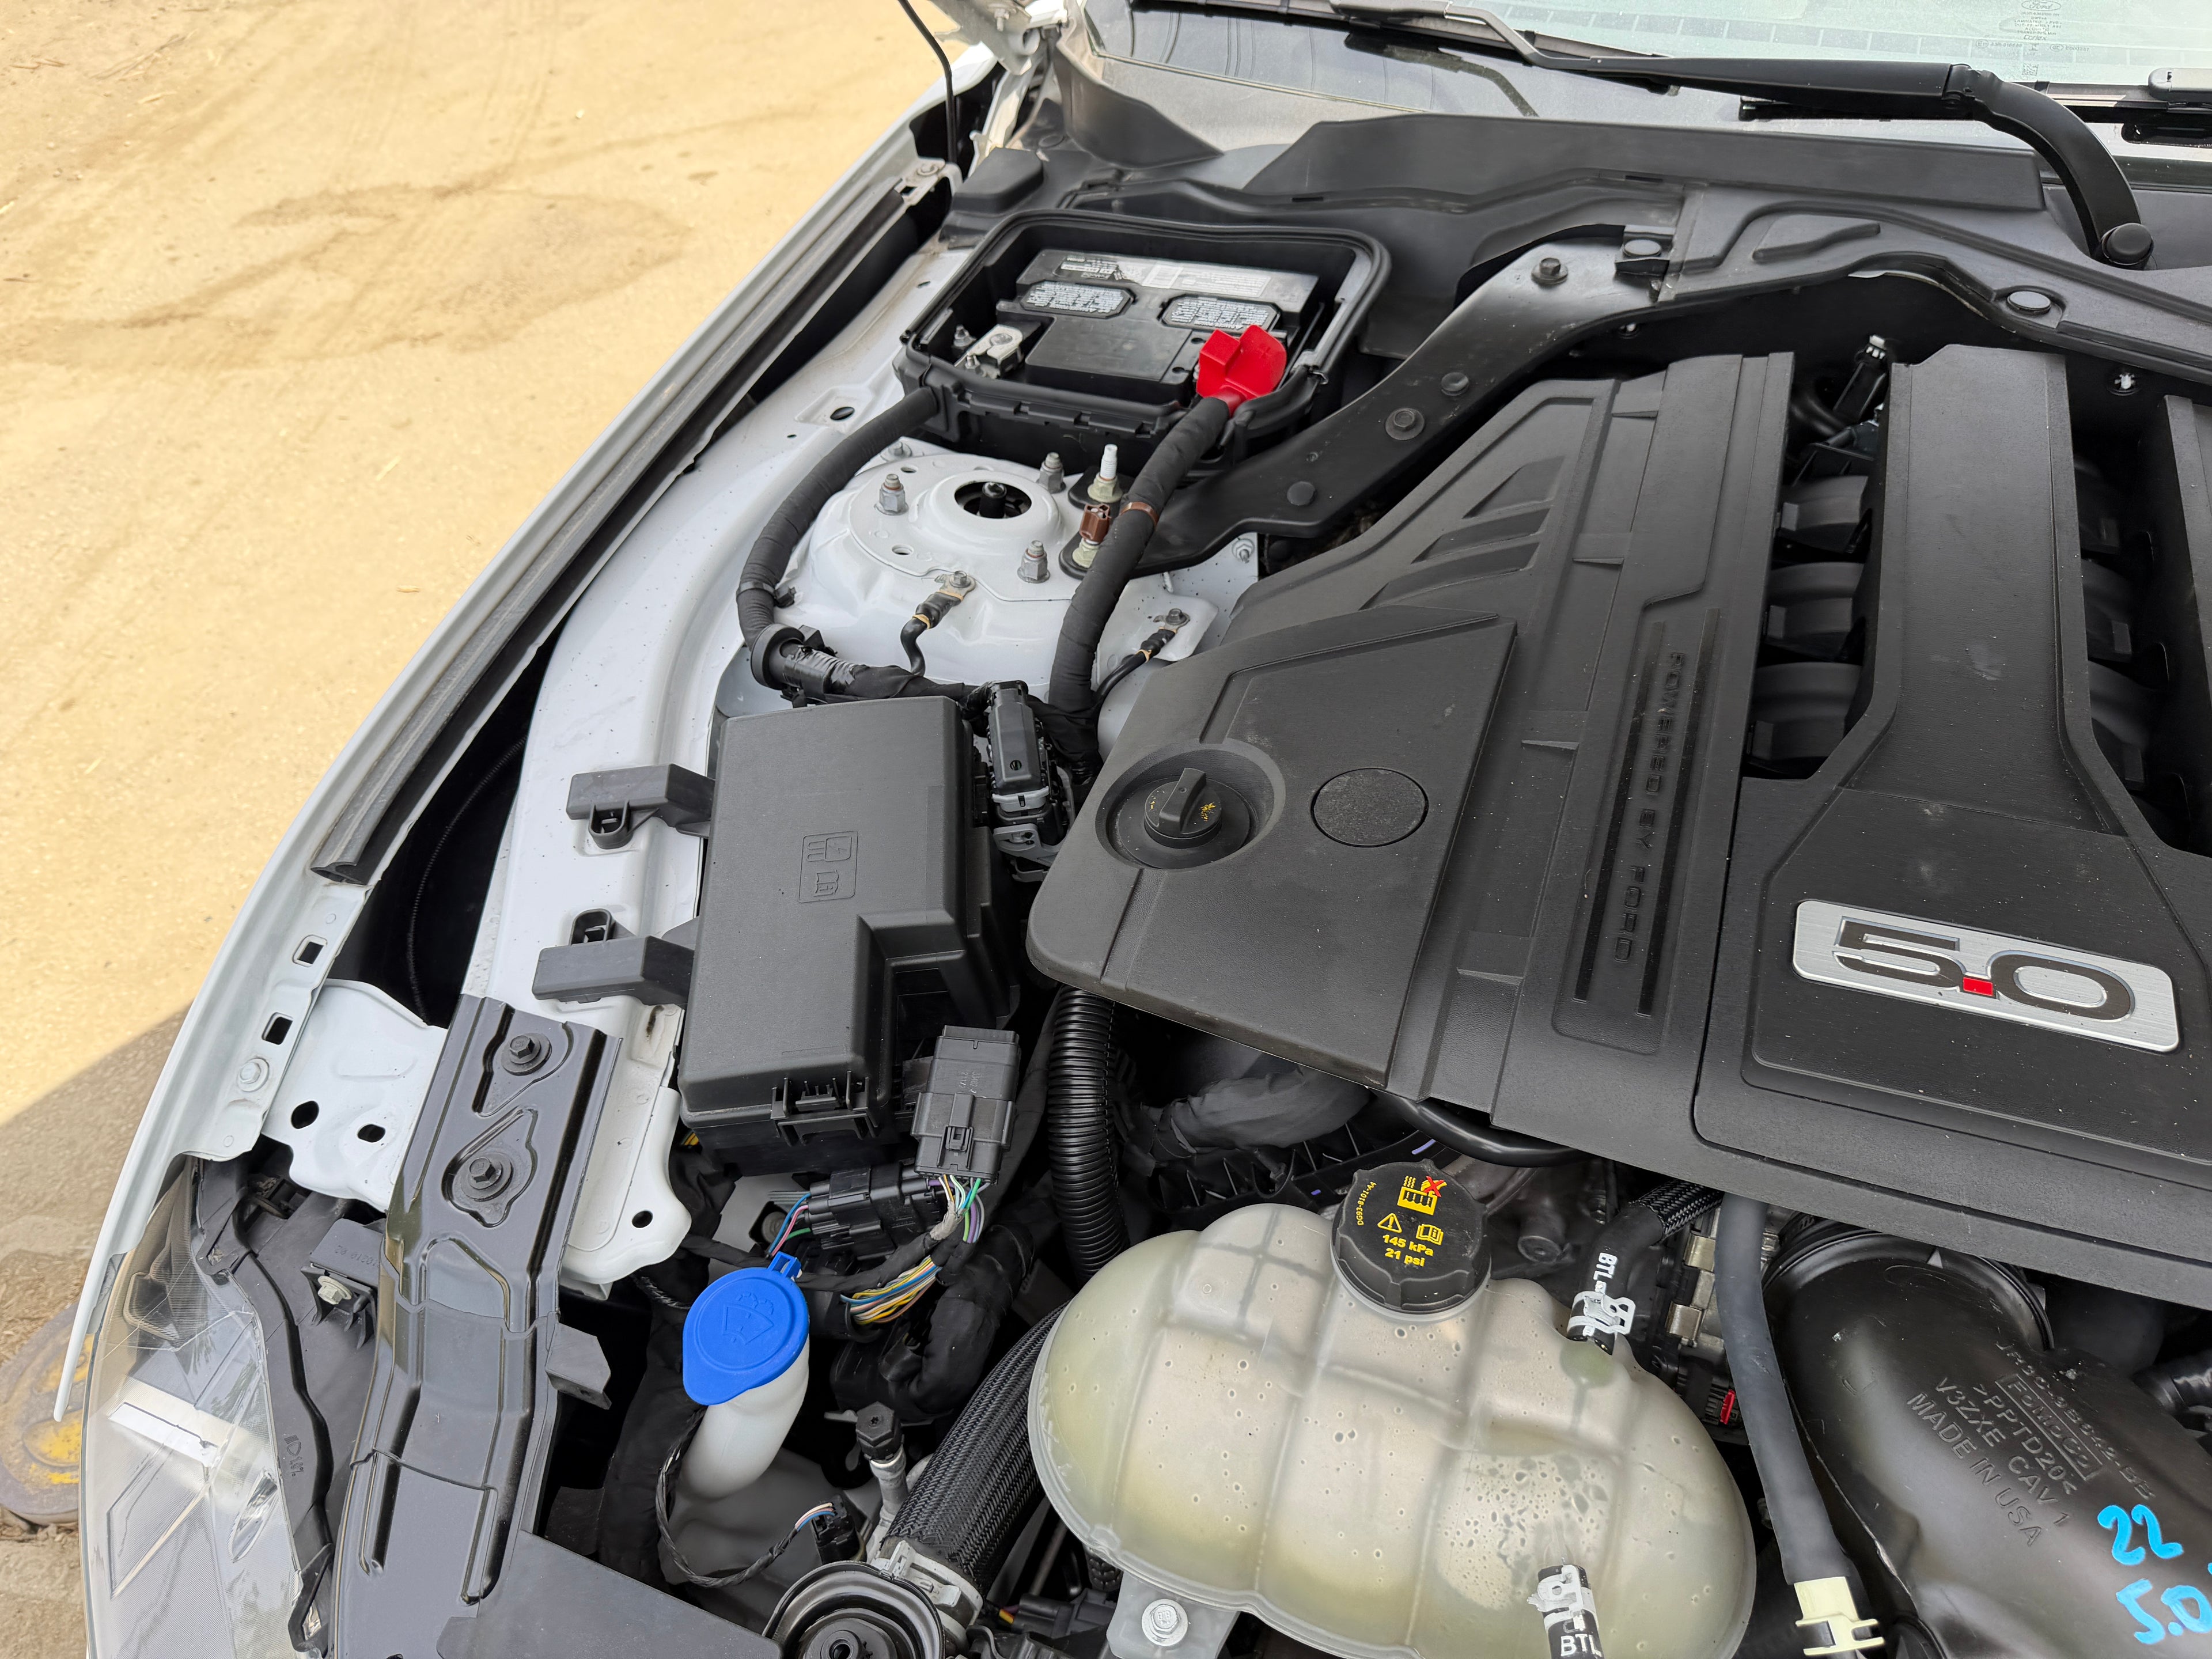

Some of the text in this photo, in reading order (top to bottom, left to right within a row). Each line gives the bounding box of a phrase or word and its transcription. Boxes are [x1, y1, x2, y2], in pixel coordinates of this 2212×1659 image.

[2029, 2, 2053, 10] Ford
[1613, 651, 1685, 963] POWERED BY FORD
[1832, 915, 2136, 1023] 5.0
[1357, 1181, 1377, 1226] DG93-8101-AA
[1382, 1234, 1434, 1257] 145 kPa
[1384, 1248, 1425, 1267] 21 psi
[1593, 1252, 1619, 1281] BTL
[1907, 1392, 2043, 1548] MADE IN USA
[2008, 1456, 2059, 1506] CAV
[2053, 1512, 2072, 1528] 1
[2097, 1504, 2184, 1566] 22
[2116, 1578, 2212, 1645] 5.0
[1560, 1634, 1603, 1658] BTL
